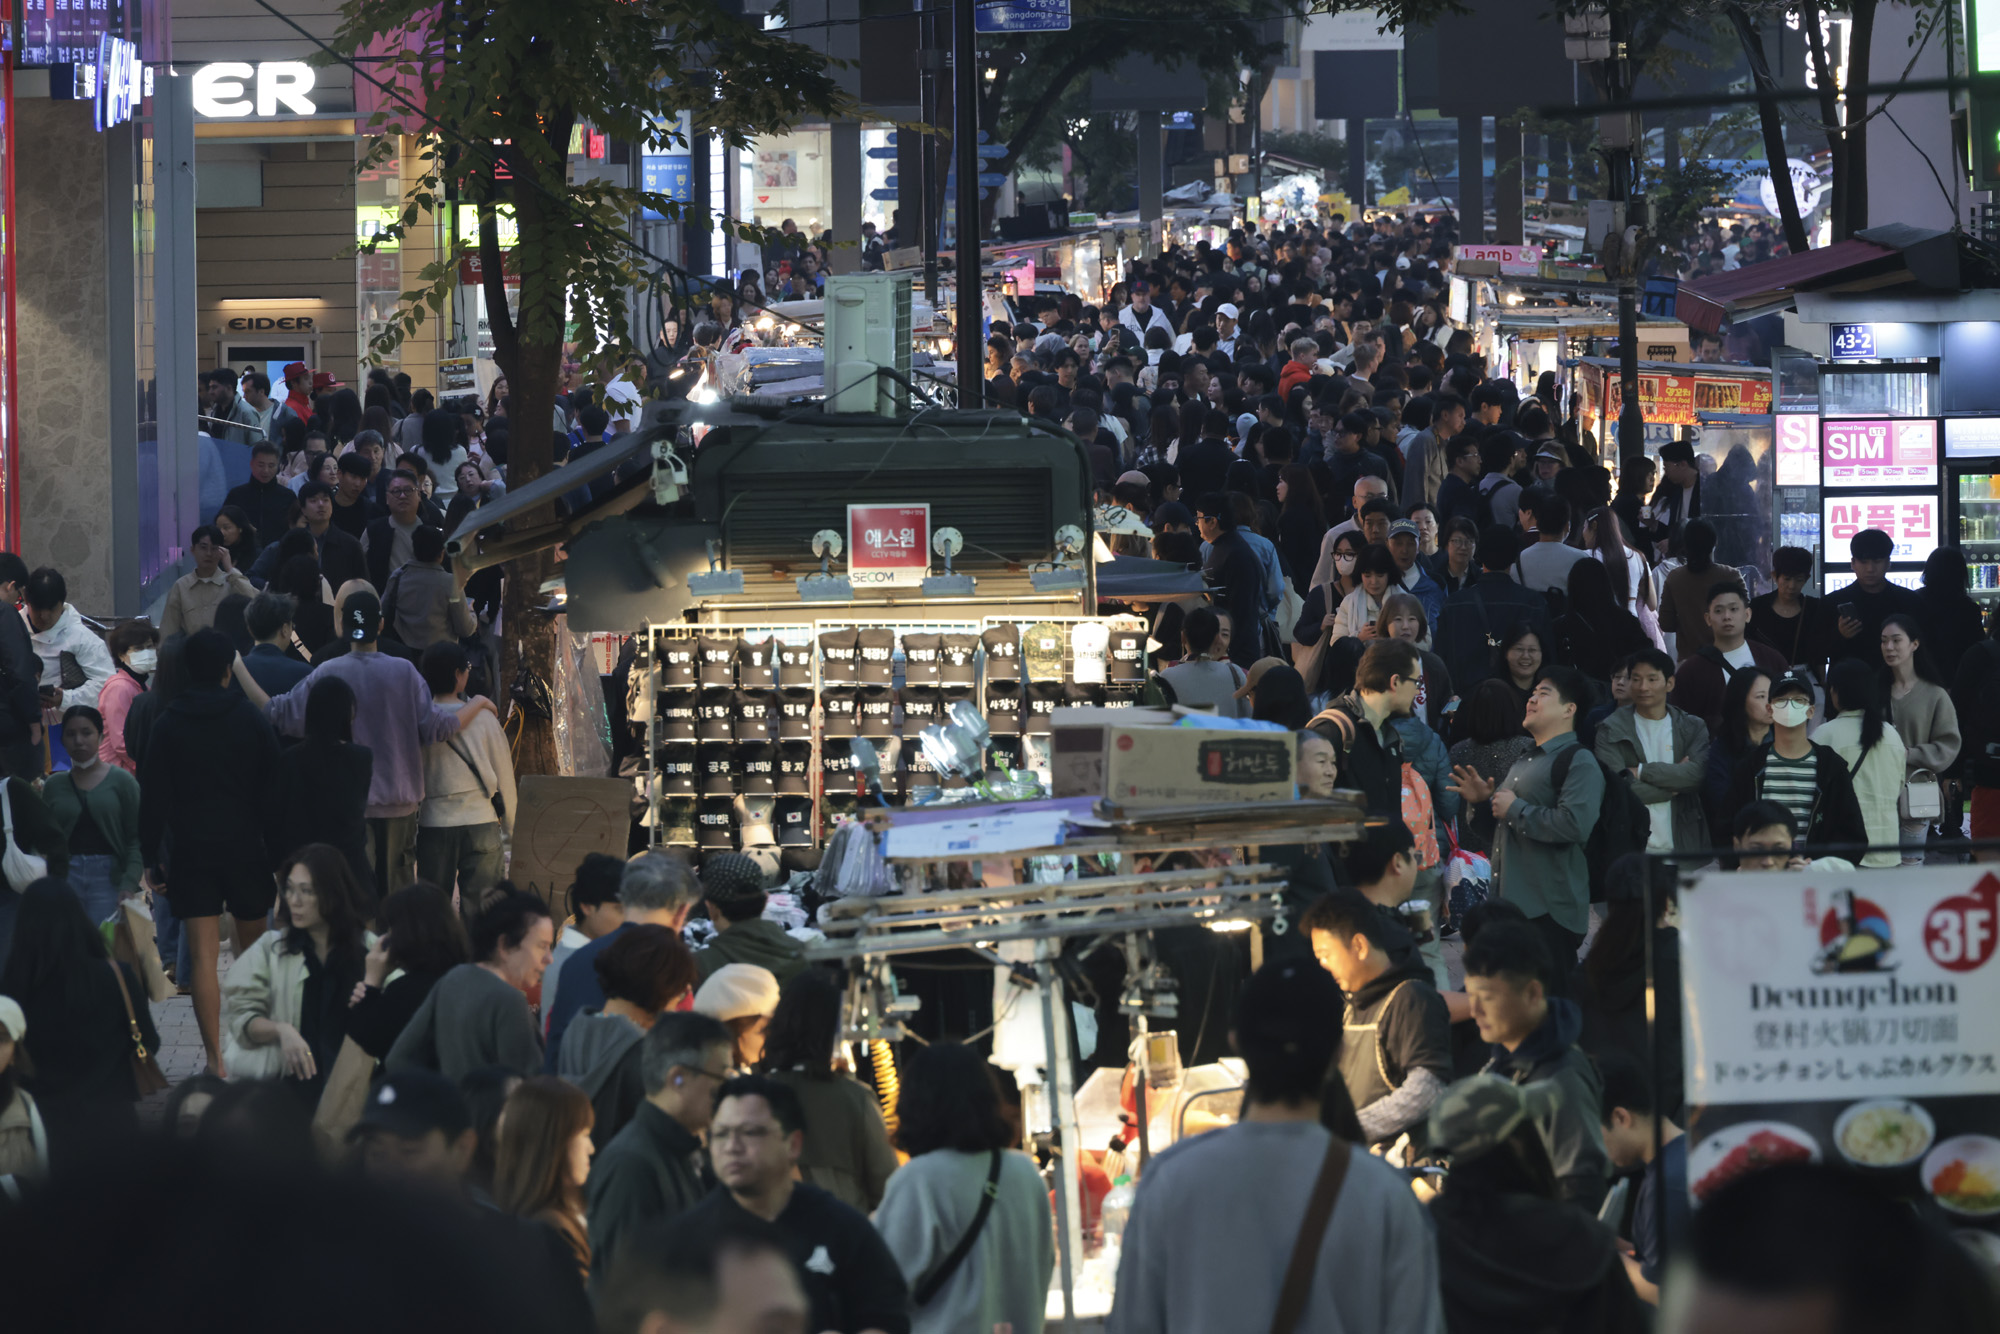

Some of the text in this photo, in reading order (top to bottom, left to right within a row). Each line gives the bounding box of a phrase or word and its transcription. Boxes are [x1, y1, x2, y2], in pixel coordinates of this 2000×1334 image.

[228, 317, 313, 330] EIDER
[1835, 333, 1872, 349] 43-2
[1828, 433, 1884, 460] SIM
[1831, 504, 1931, 539] 상품권
[865, 528, 915, 548] 에스원
[853, 572, 894, 582] SECOM
[706, 650, 730, 662] 아빠
[992, 643, 1015, 656] 서울
[668, 652, 690, 664] 엄마
[743, 705, 766, 718] 친구
[784, 704, 807, 717] 대박
[829, 701, 854, 713] 오빠
[708, 761, 730, 772] 공주
[781, 761, 805, 772] 왕자
[1930, 909, 1992, 962] 3F
[1750, 978, 1957, 1012] Deungchon
